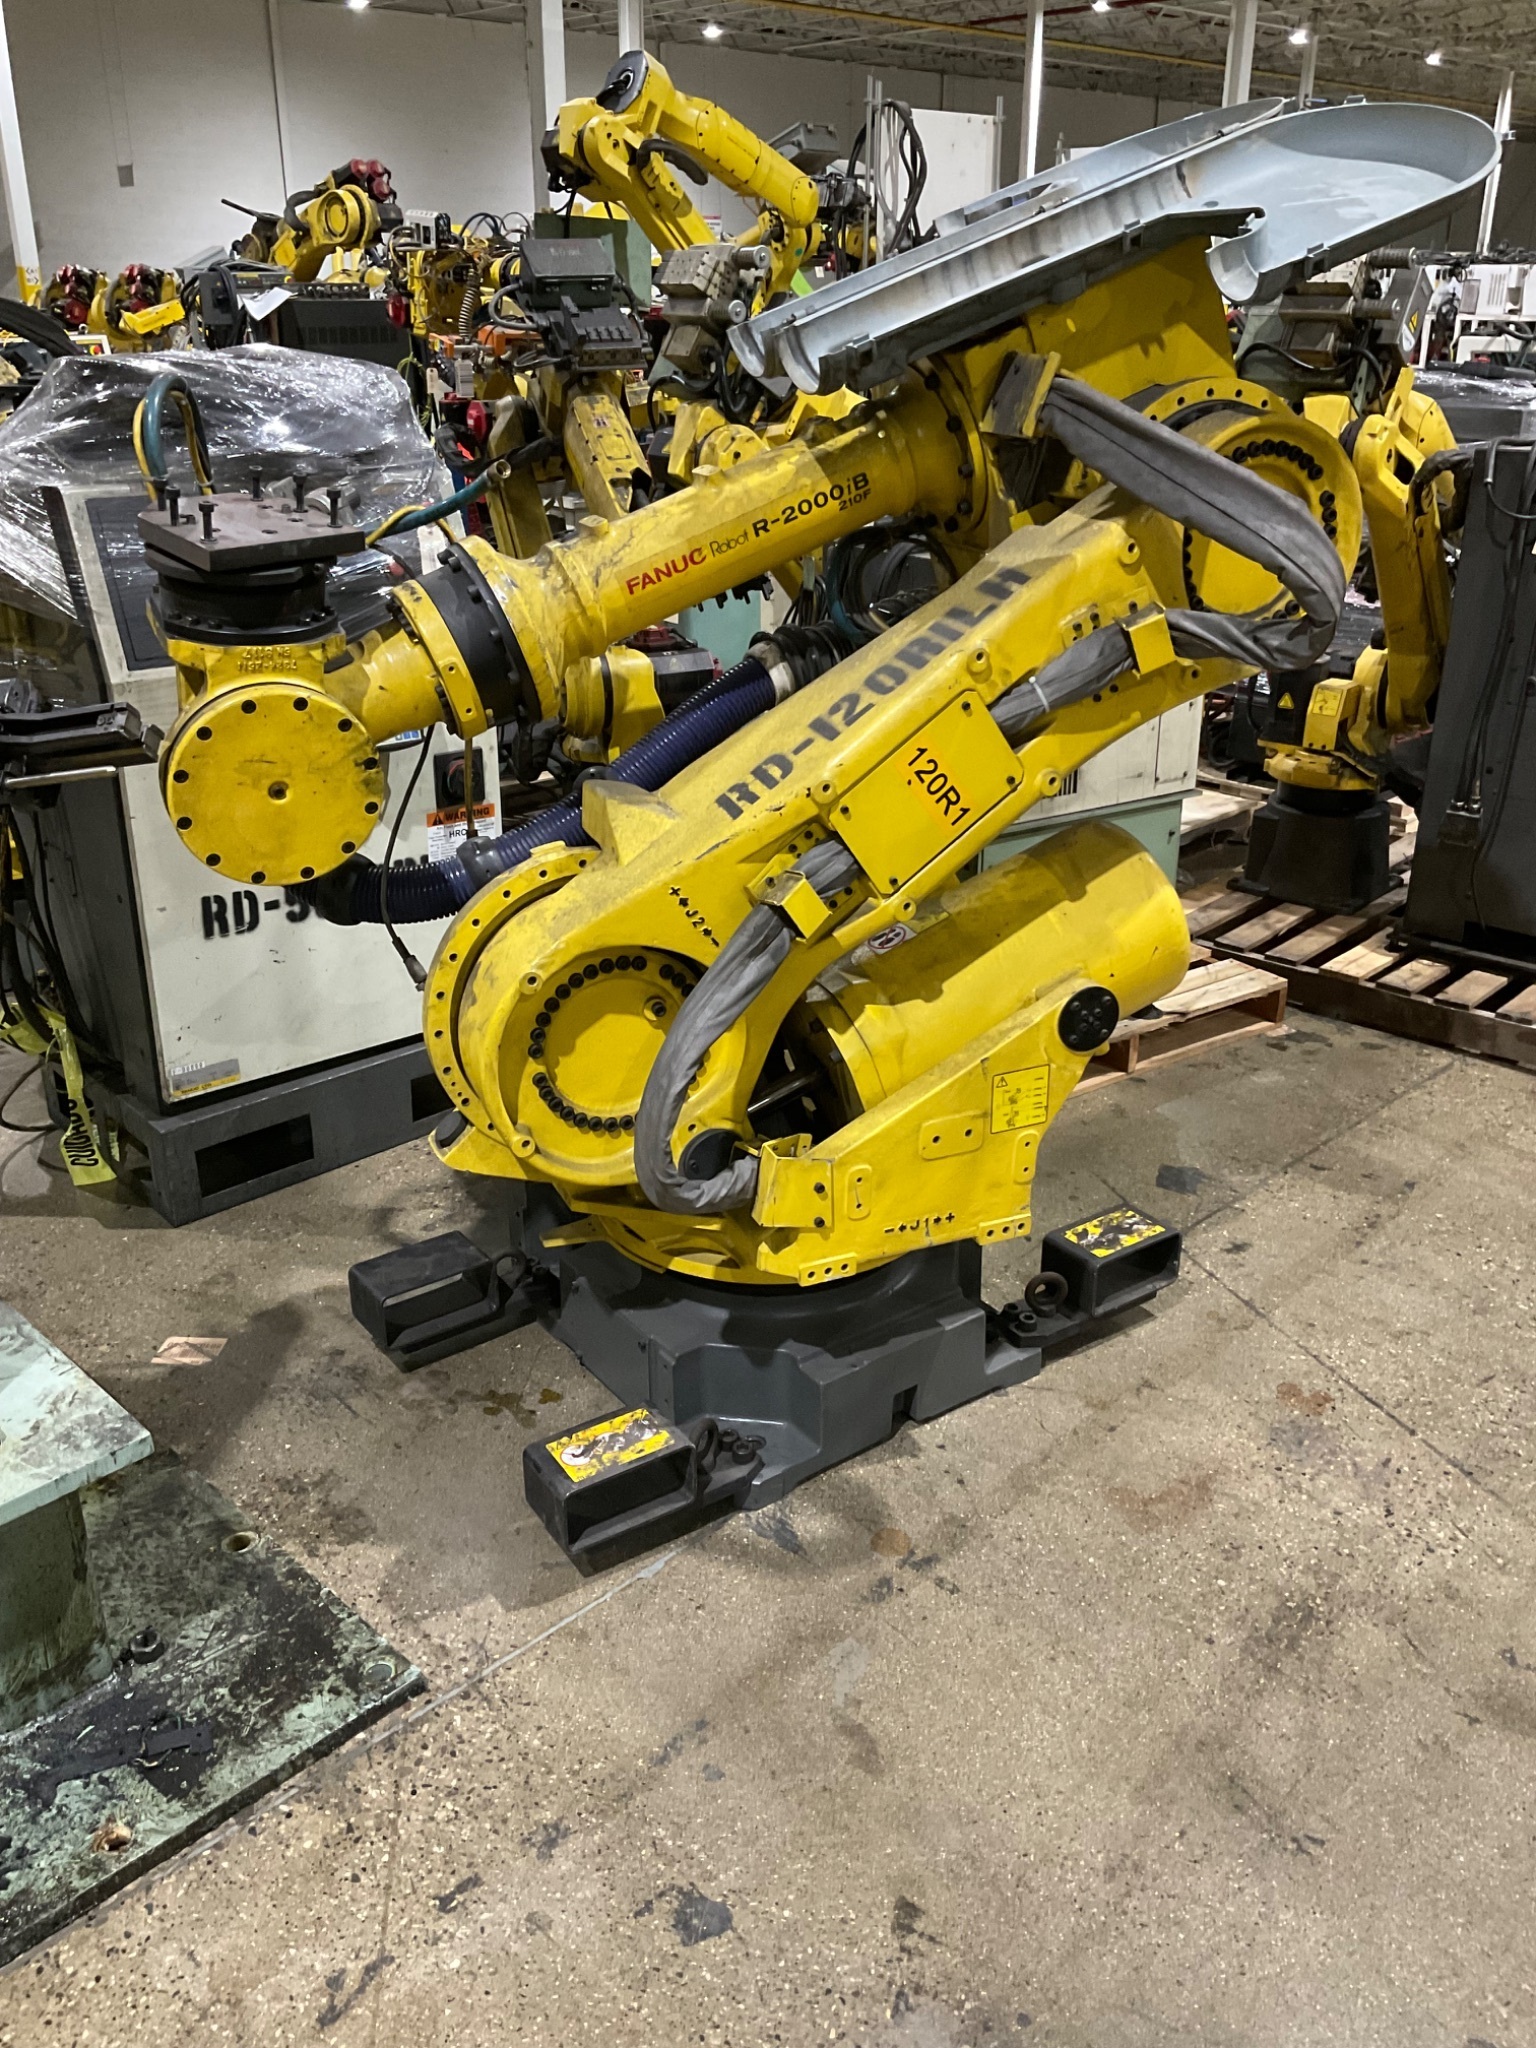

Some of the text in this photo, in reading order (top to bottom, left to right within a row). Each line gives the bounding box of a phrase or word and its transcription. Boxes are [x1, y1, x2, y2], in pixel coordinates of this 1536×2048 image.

[838, 489, 872, 512] 210F
[625, 472, 870, 595] FANUC Robot R-2000iB
[907, 747, 971, 826] 120R1
[445, 806, 490, 821] WARING
[685, 909, 706, 928] J2
[909, 1217, 929, 1231] J1
